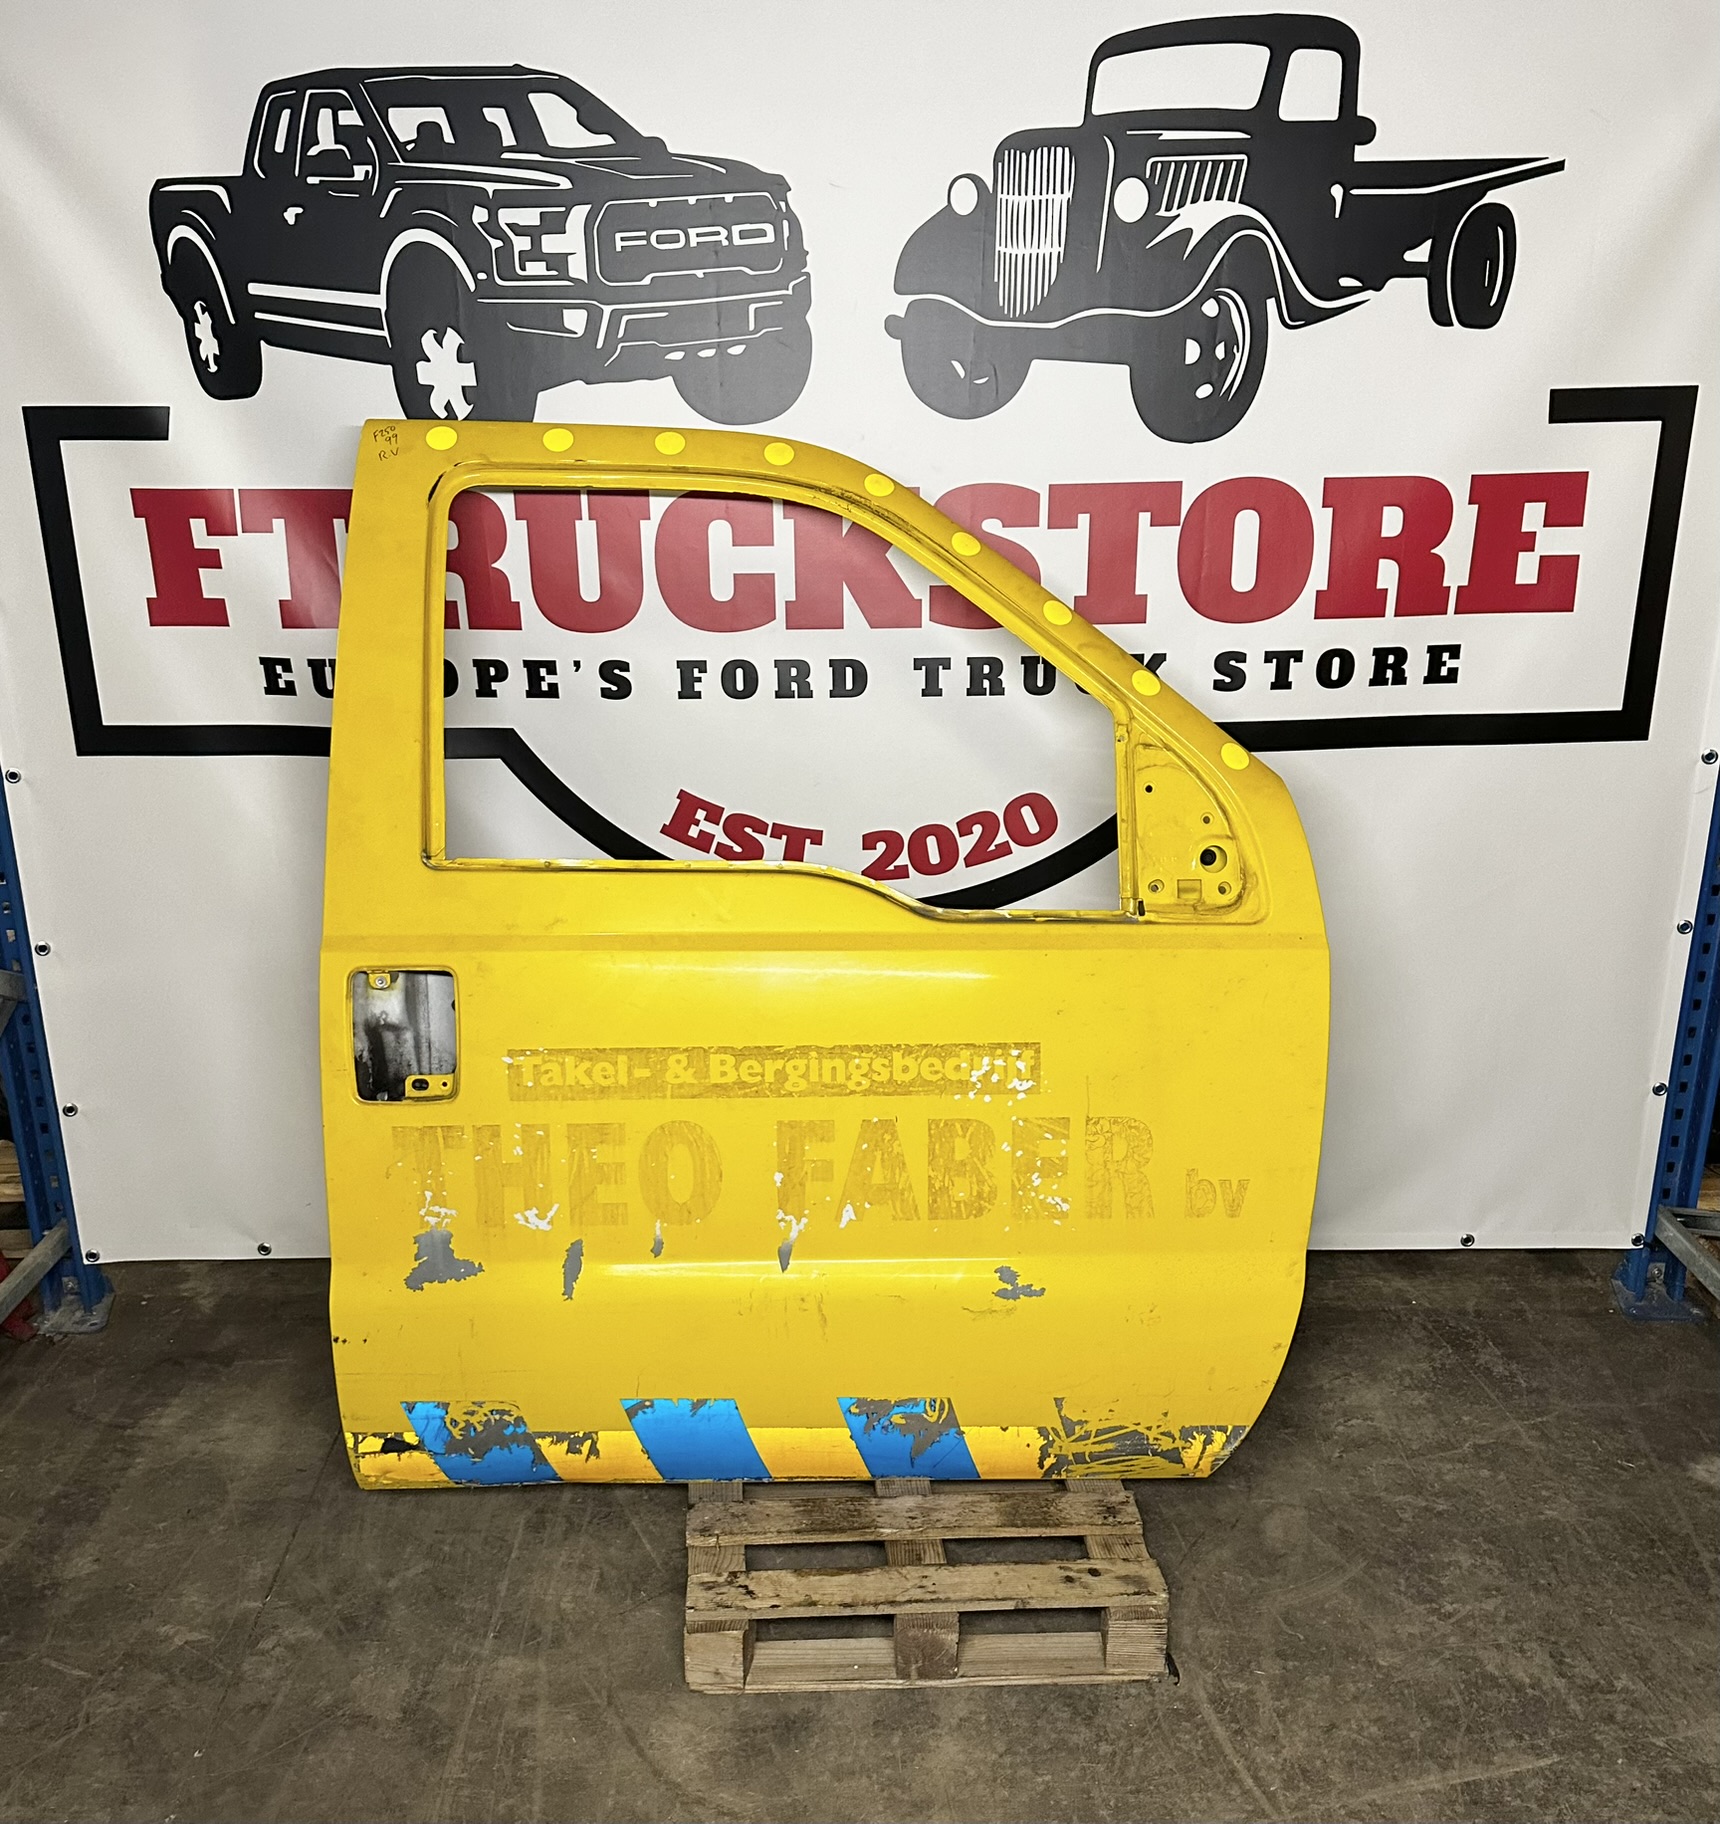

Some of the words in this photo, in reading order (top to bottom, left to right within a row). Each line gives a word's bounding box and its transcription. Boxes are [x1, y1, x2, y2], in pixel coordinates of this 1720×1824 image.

[615, 223, 776, 252] FORD
[373, 425, 396, 443] F250
[384, 433, 398, 446] 99
[131, 471, 1589, 634] FTRUCKSTORE
[258, 656, 633, 701] EUPE'S
[677, 659, 867, 700] FORD
[913, 652, 1168, 698] TRU
[1213, 643, 1462, 692] STORE
[660, 788, 824, 862] EST
[861, 792, 1059, 881] 2020
[513, 1053, 652, 1087] Takel-
[665, 1053, 704, 1085] &
[709, 1049, 1036, 1091] Bergingsbedrijf
[392, 1120, 723, 1230] THEO
[776, 1116, 1156, 1222] FABER
[1183, 1168, 1252, 1219] bv
